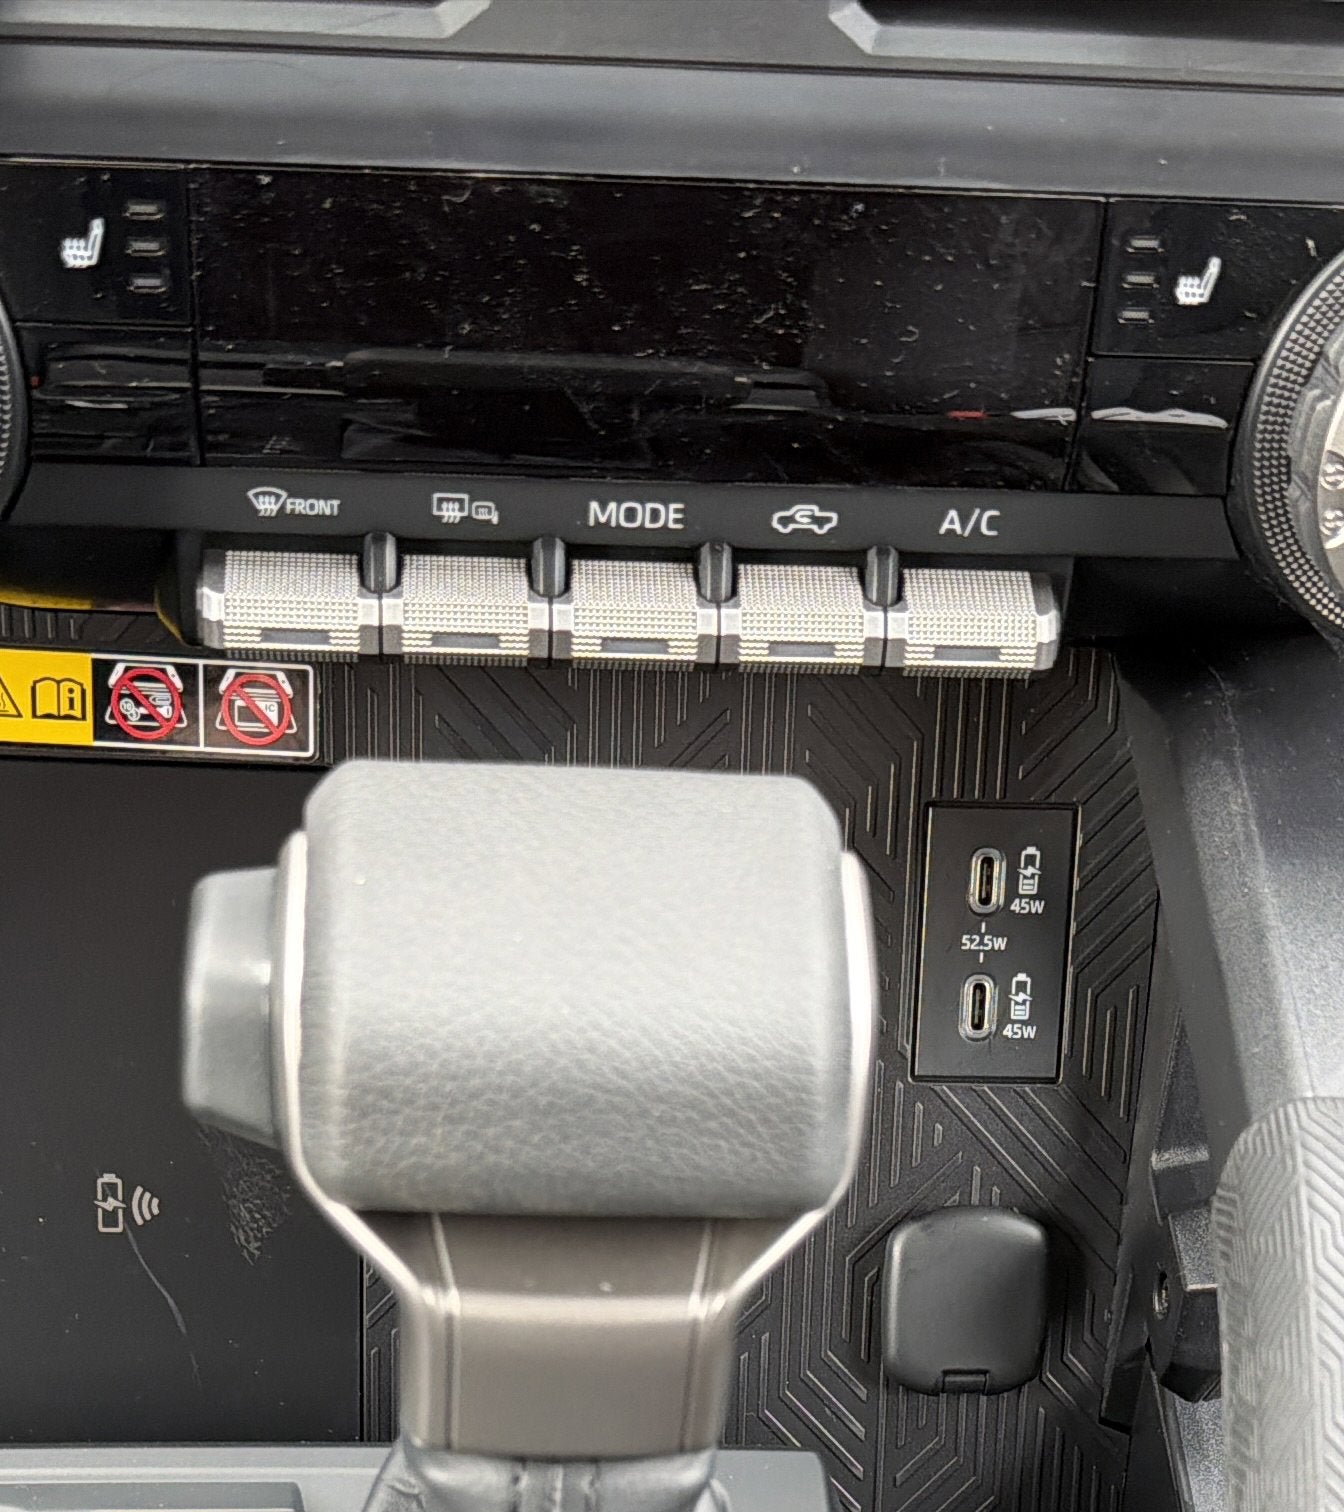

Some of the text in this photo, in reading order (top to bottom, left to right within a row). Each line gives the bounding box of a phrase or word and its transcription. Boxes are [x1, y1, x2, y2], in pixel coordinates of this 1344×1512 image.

[286, 497, 341, 518] FRONT
[589, 501, 685, 531] MODE
[940, 508, 1001, 537] A/C
[1009, 899, 1045, 915] 45W
[961, 935, 1007, 951] 52.5W
[1003, 1024, 1037, 1039] 45W
